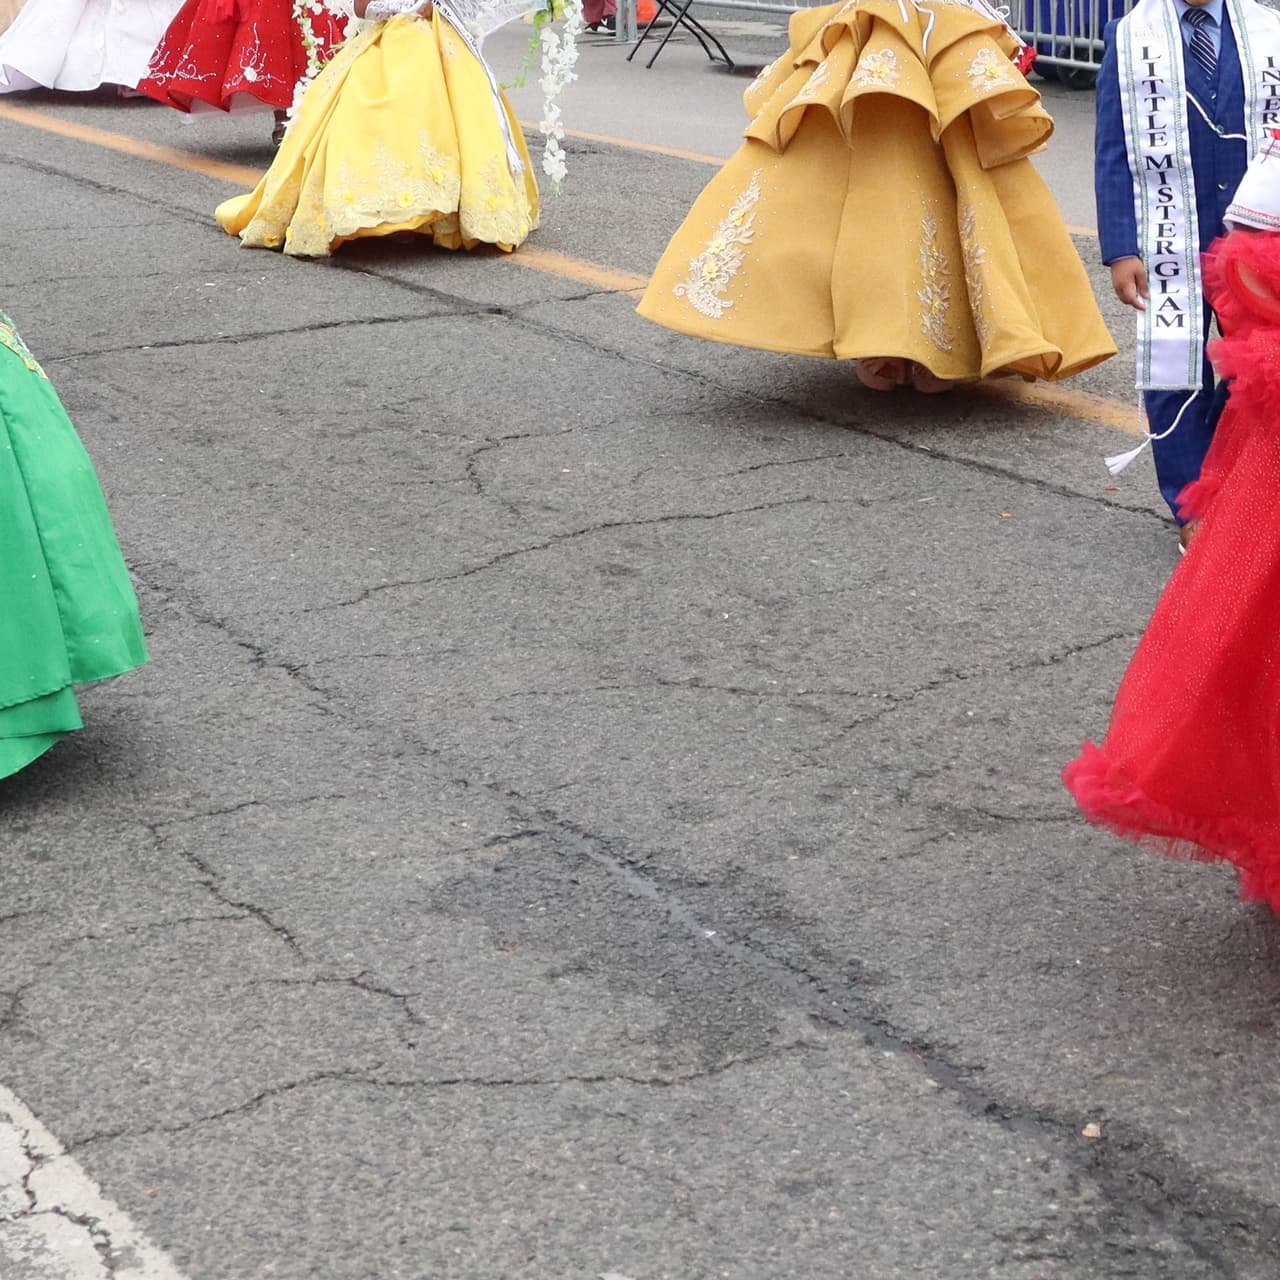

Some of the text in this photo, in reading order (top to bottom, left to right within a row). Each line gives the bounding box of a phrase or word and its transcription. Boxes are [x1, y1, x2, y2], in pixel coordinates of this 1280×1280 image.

[1141, 46, 1168, 147] LITTLE
[1144, 154, 1177, 255] MISTER
[1154, 261, 1185, 328] GLAM
